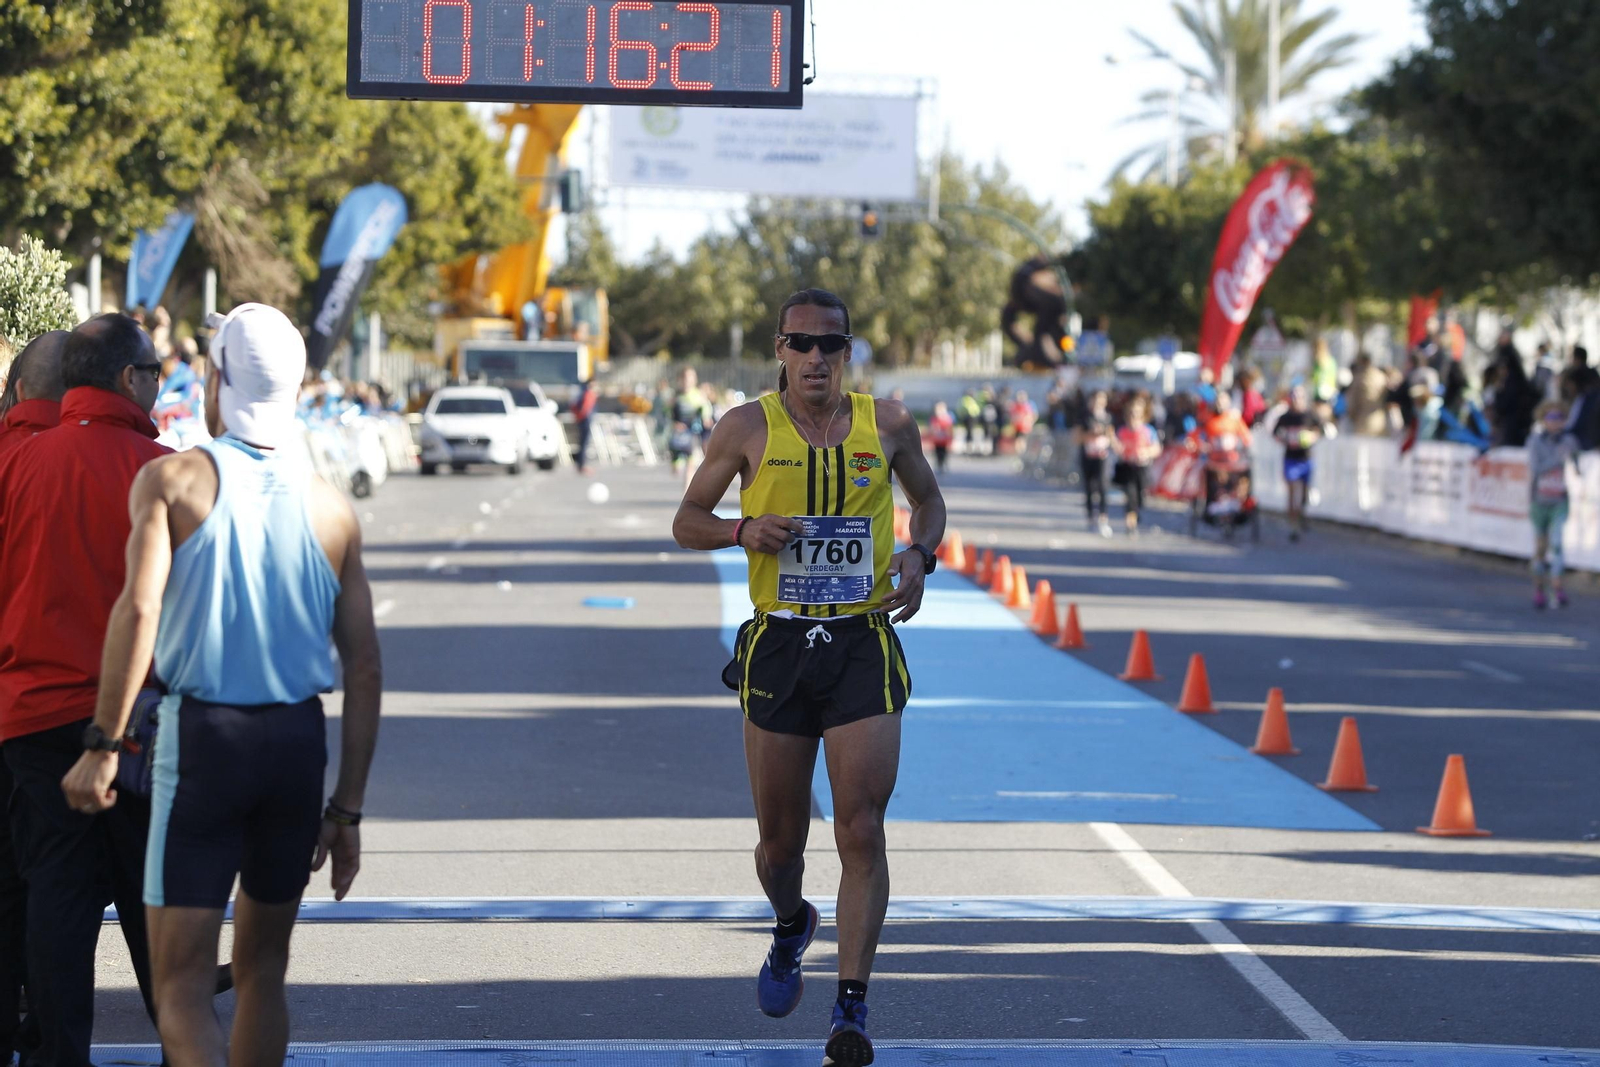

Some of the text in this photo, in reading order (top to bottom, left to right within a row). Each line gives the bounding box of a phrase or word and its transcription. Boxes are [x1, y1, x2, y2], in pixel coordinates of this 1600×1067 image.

[767, 458, 793, 467] daen
[790, 539, 863, 565] 1760
[804, 564, 845, 572] VERDEGAY
